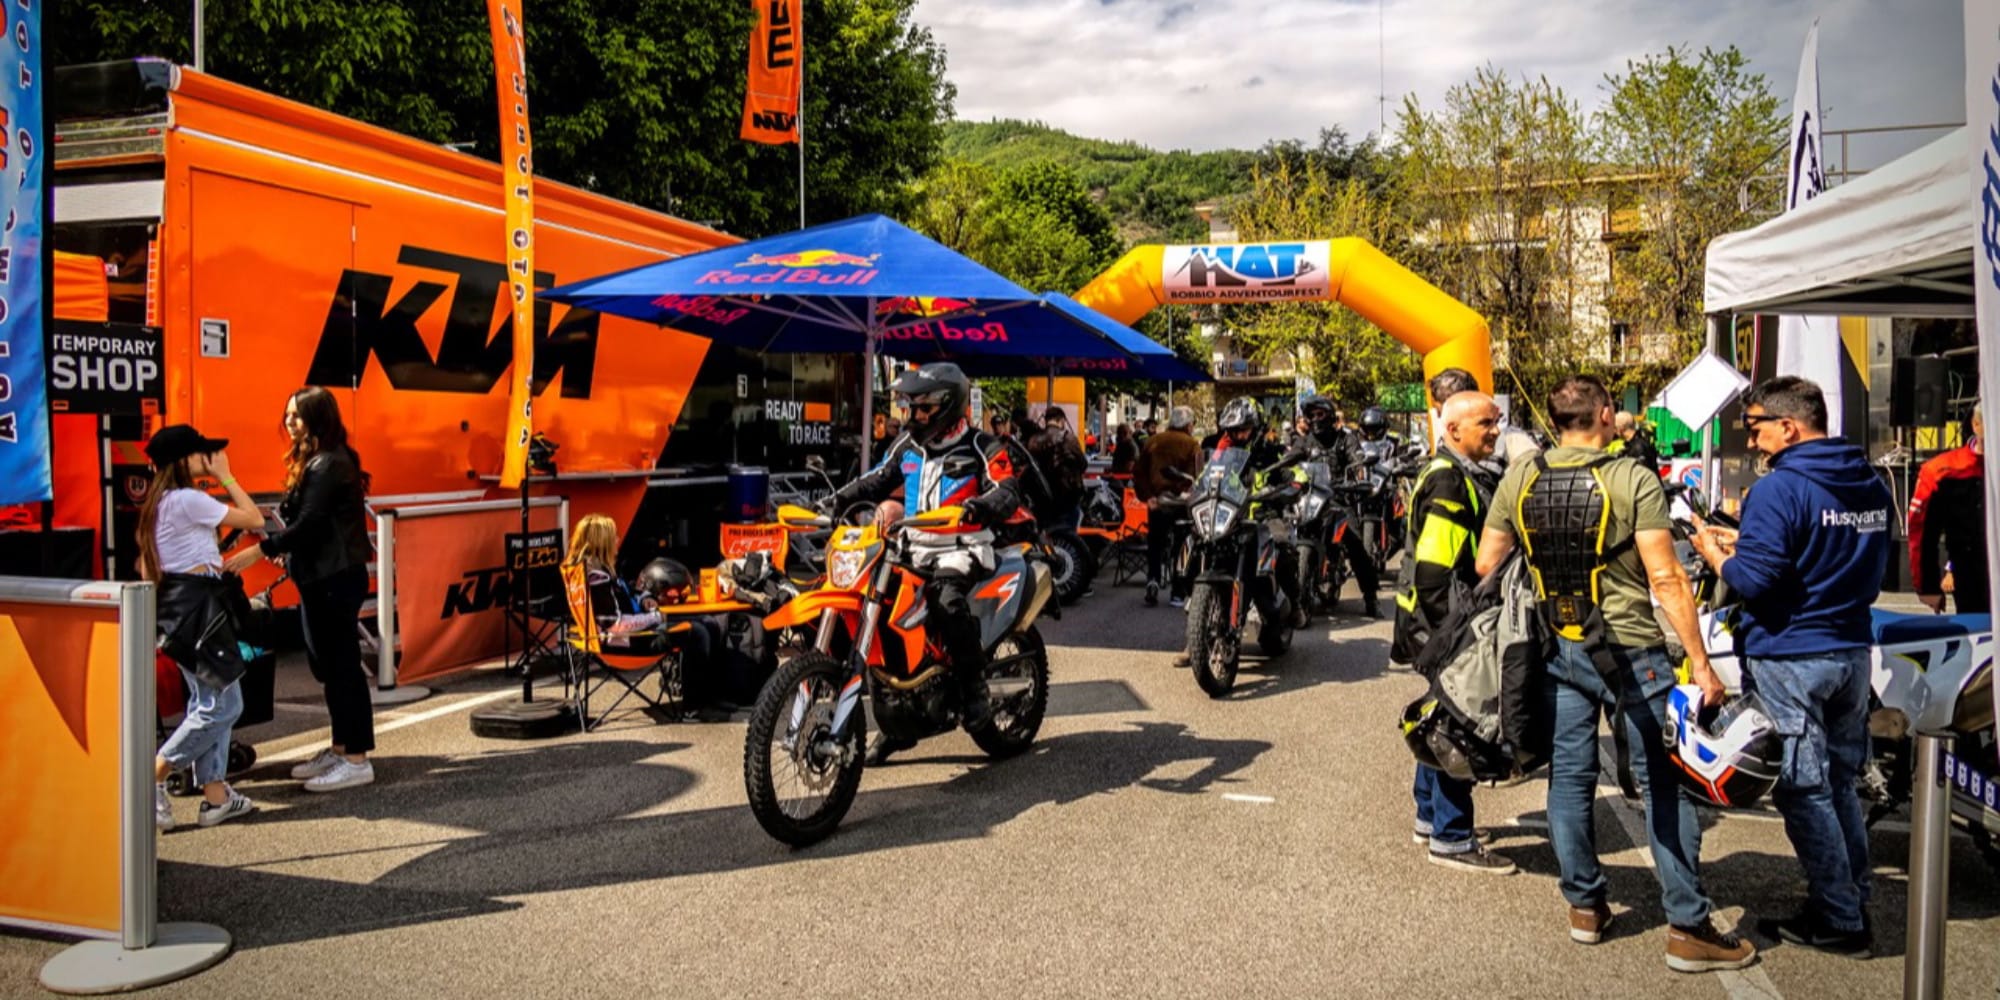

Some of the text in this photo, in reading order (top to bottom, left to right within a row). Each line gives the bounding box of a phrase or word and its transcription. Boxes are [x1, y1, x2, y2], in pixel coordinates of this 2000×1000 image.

[1190, 244, 1305, 287] HAT
[694, 268, 878, 285] Red Bull
[1170, 287, 1322, 300] BOBBIO ADVENTOURFEST
[304, 244, 600, 400] KTM
[52, 335, 157, 355] TEMPORARY
[52, 354, 158, 392] SHOP
[765, 400, 803, 420] READY
[789, 425, 831, 444] TO RACE
[1822, 508, 1888, 528] Husqvarna
